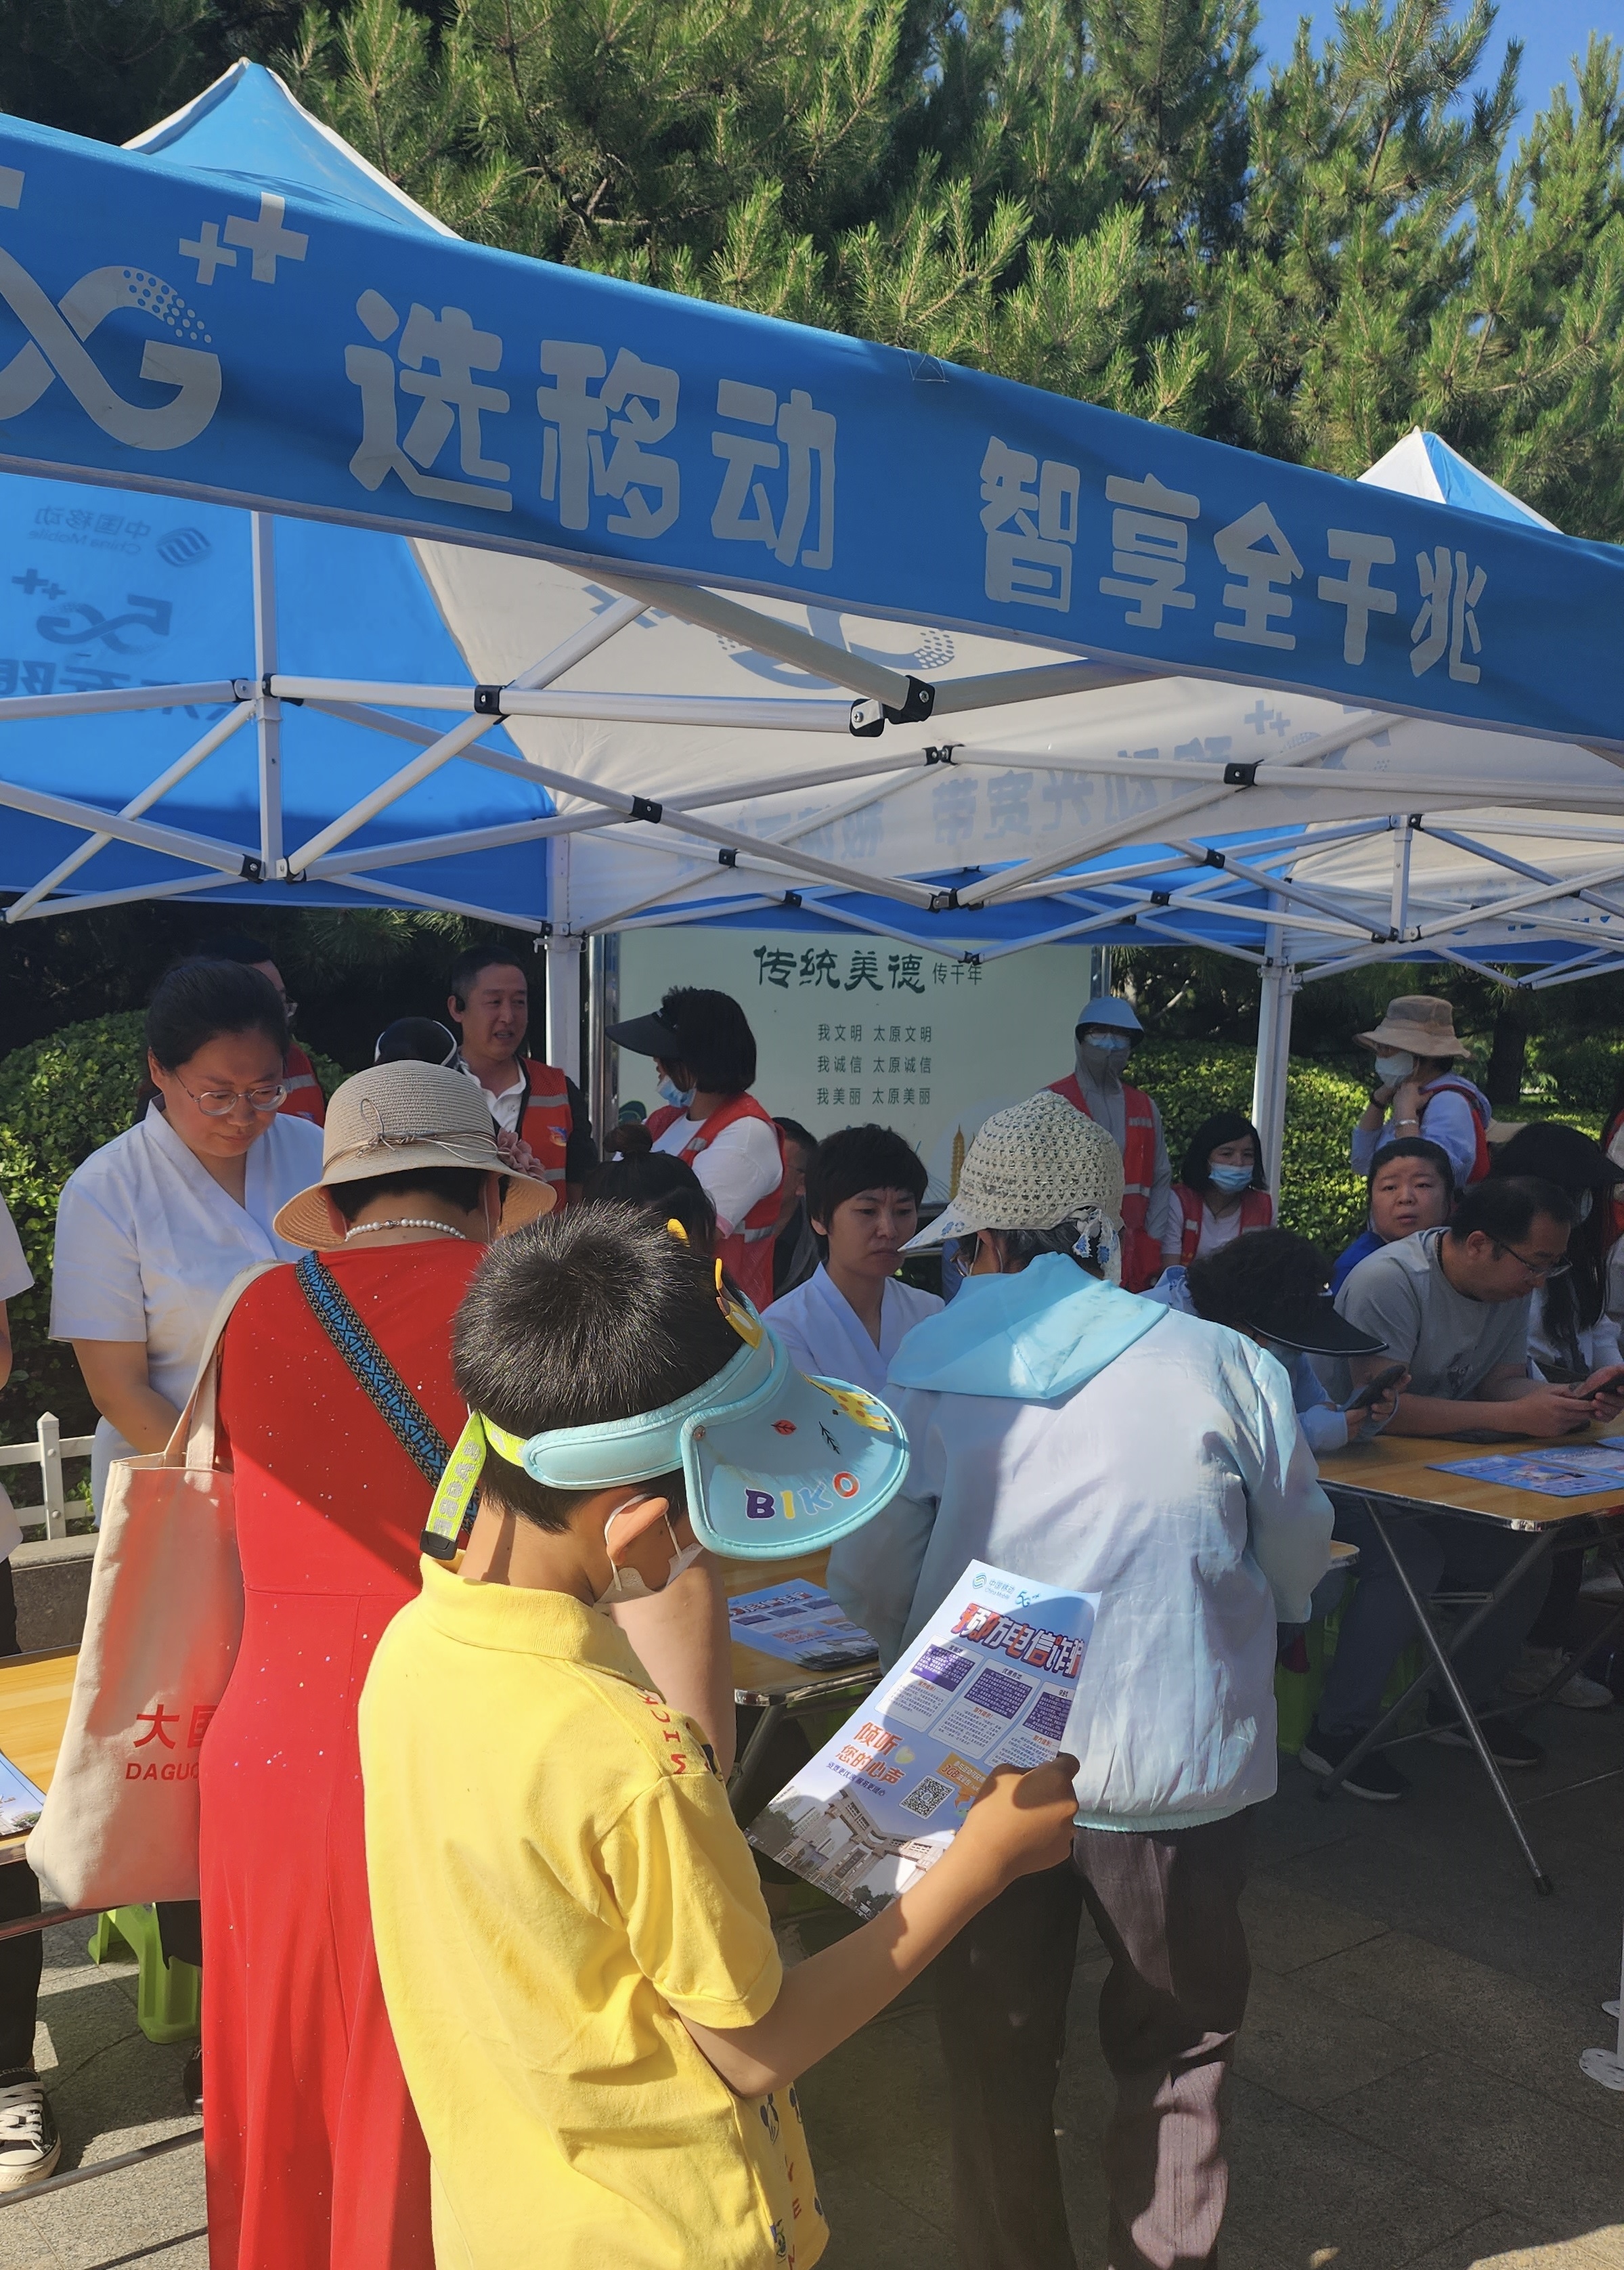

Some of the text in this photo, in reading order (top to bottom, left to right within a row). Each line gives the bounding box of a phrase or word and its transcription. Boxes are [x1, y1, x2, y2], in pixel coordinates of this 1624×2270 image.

[344, 288, 837, 570] 选移动
[979, 435, 1487, 684] 智享全千兆
[753, 944, 983, 994] 传统美德 传千年
[817, 1023, 932, 1043] 我文明 太原文明
[817, 1055, 931, 1074] 我诚信 太原诚信
[816, 1087, 931, 1106] 我美丽 太原美丽
[745, 1470, 860, 1520] BIKO
[950, 1602, 1085, 1679] 预防电信诈骗
[853, 1721, 904, 1756] 倾听
[835, 1744, 906, 1785] 您的心声
